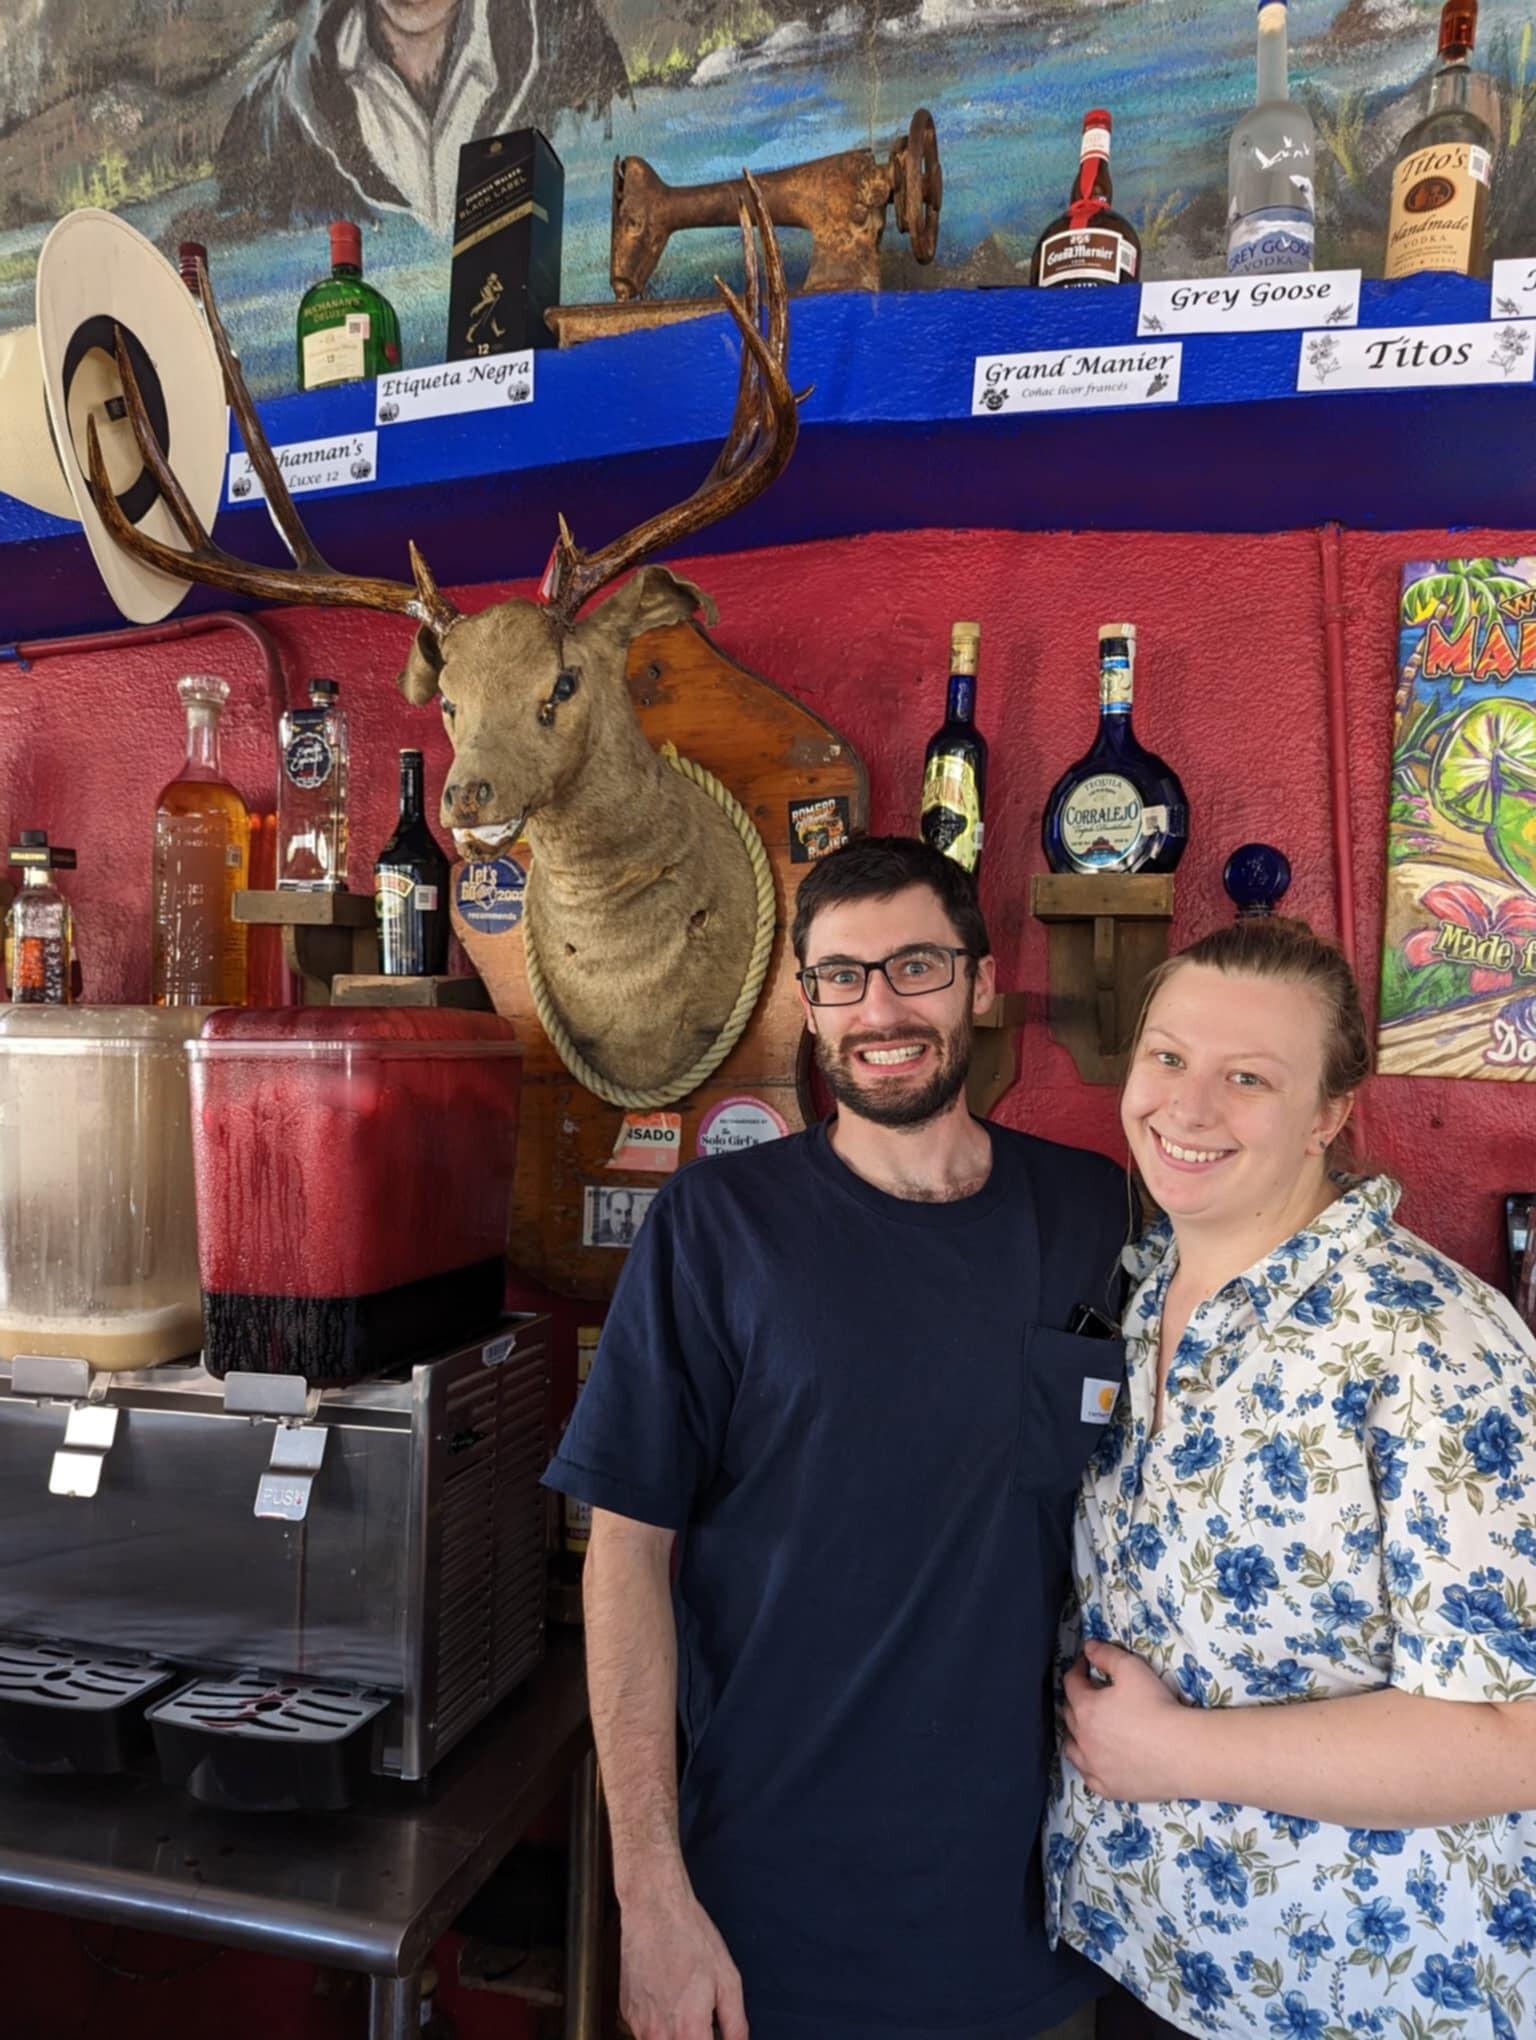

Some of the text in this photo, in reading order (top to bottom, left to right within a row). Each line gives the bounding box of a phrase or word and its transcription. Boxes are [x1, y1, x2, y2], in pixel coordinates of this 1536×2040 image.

[1170, 282, 1332, 312] Grey Goose
[478, 344, 490, 355] 12
[382, 359, 531, 398] Etiqueta Negra
[985, 352, 1174, 386] Grand Manier
[327, 471, 339, 482] 12
[1084, 778, 1122, 791] TEQUILA
[1066, 799, 1139, 826] CORRALEJO
[1432, 920, 1513, 972] Made
[701, 1134, 727, 1146] Solo
